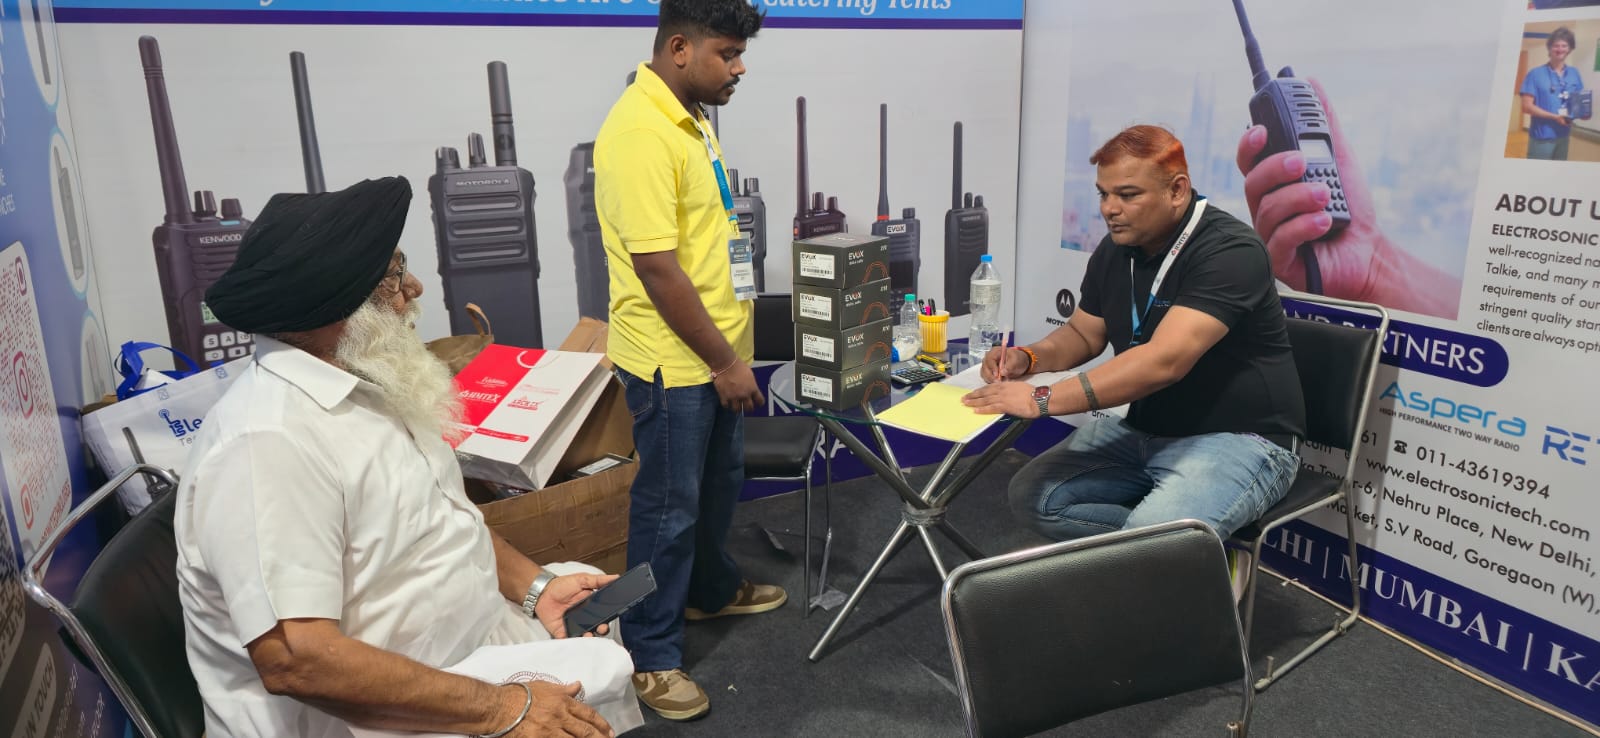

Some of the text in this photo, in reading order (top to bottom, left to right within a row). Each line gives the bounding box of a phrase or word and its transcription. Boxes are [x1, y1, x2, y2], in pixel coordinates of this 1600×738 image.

[1494, 193, 1582, 218] ABOUT
[200, 233, 241, 244] KENWOOD
[1491, 223, 1599, 246] ELECTROSONIC
[1488, 244, 1583, 265] well-recognized
[1486, 262, 1521, 279] Talkie,
[1525, 269, 1550, 281] and
[1553, 274, 1589, 290] many
[1482, 284, 1556, 303] requirements
[1561, 293, 1576, 306] of
[1479, 302, 1527, 318] stringent
[1531, 312, 1573, 328] quality
[1476, 320, 1510, 335] clients
[1511, 328, 1532, 339] are
[1532, 330, 1575, 349] always
[1379, 381, 1527, 437] Aspera
[1379, 407, 1520, 452] HIGH PERFORMANCE TWO WAY RADIO
[1542, 425, 1600, 466] RE
[1416, 445, 1551, 500] 011-43619394
[1366, 459, 1590, 541] www.electrosonictech.com
[1383, 487, 1431, 516] Nehru
[1437, 506, 1484, 538] Place,
[1491, 525, 1534, 551] New
[1539, 542, 1596, 577] Delhi,
[1326, 500, 1600, 615] Maket, S.V Road, Goregaon (W),
[1262, 528, 1314, 565] LHI
[1340, 553, 1514, 654] MUMBAI
